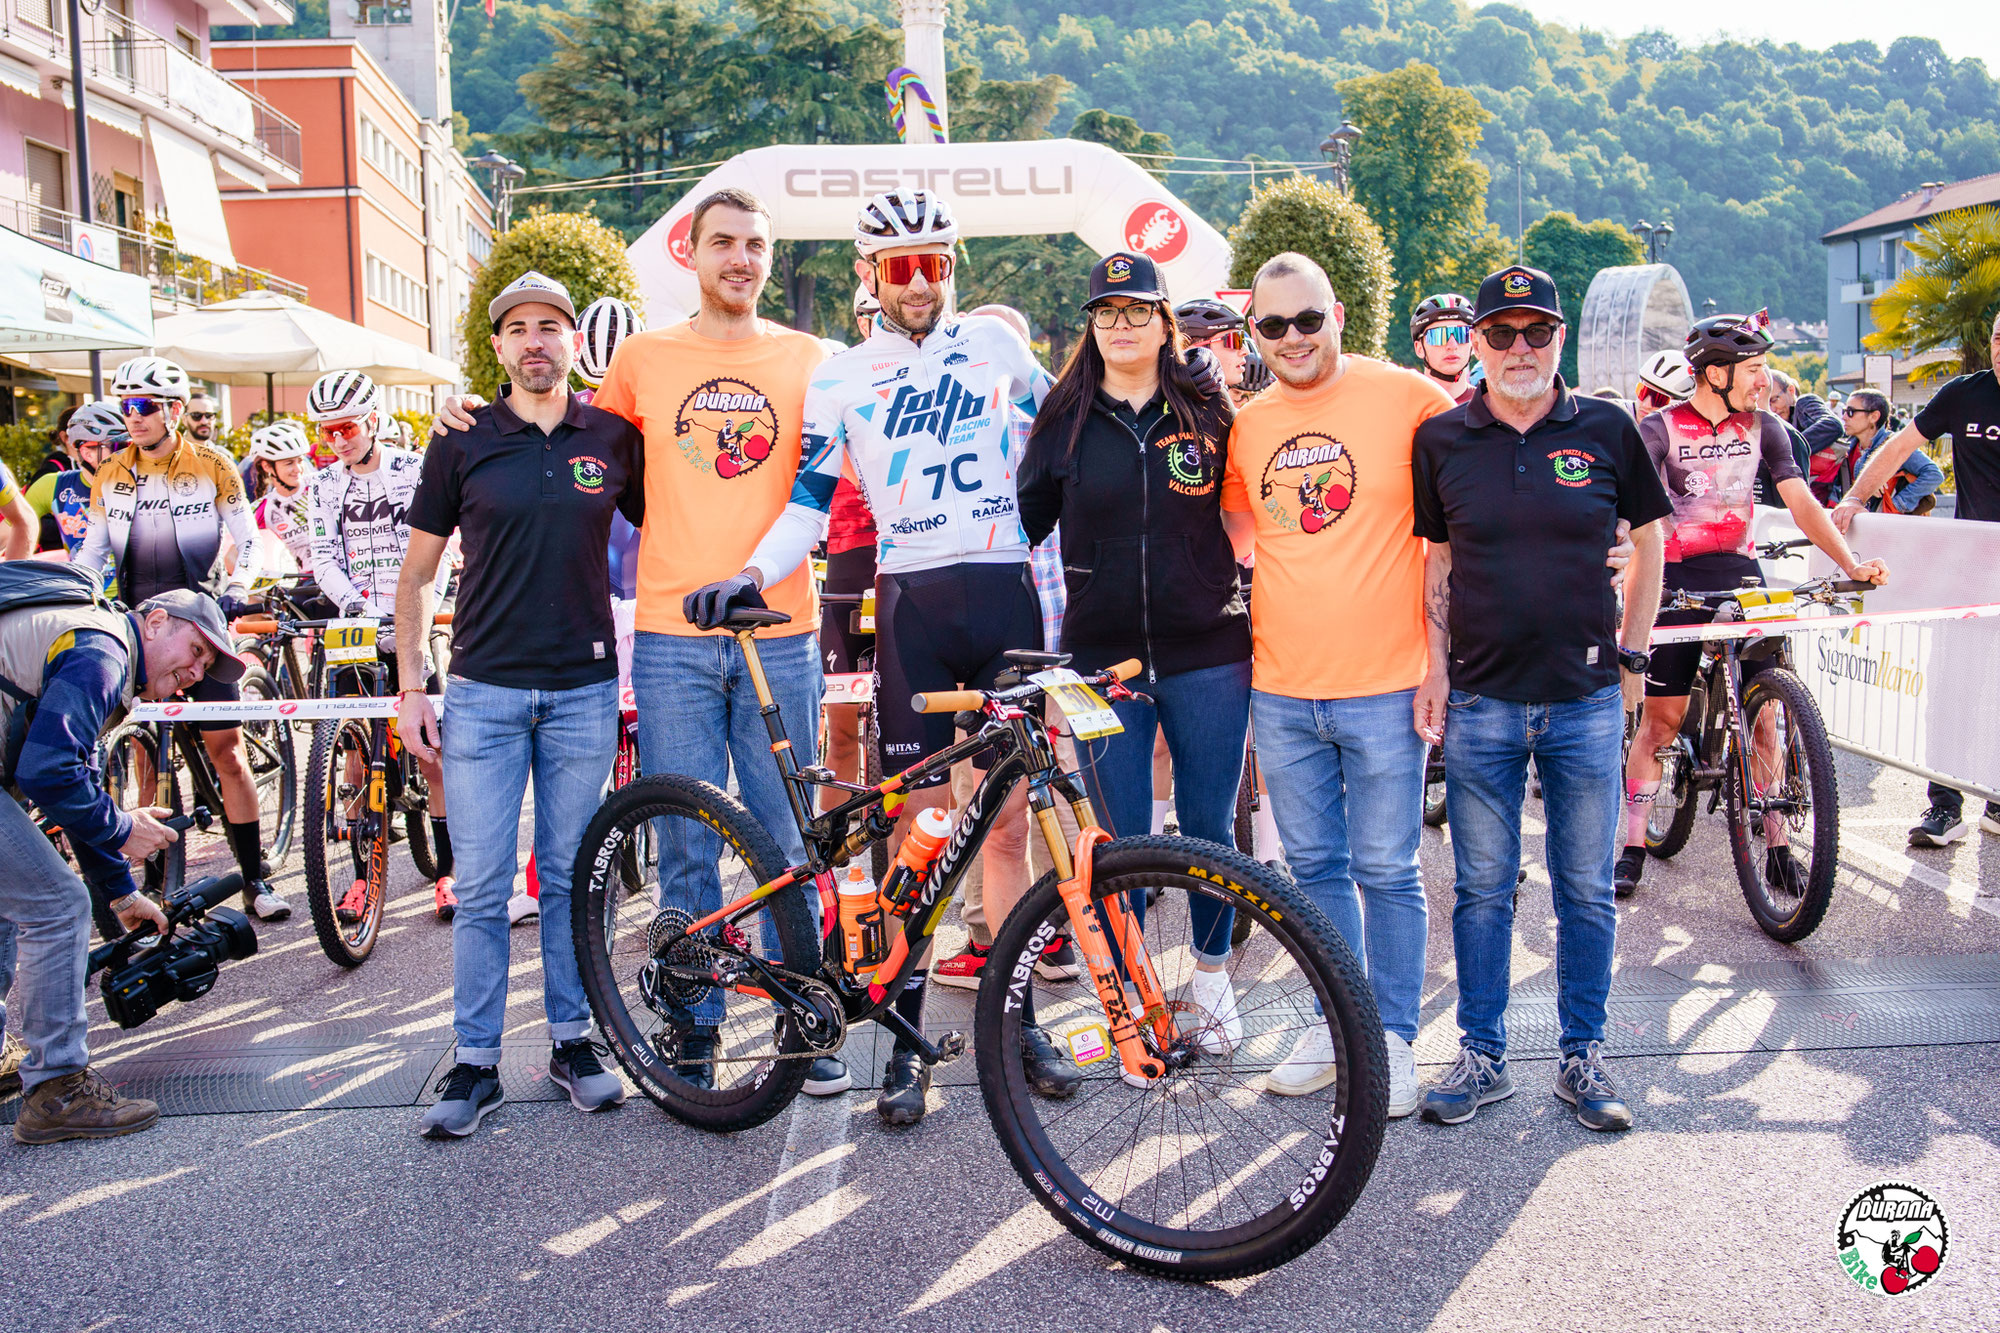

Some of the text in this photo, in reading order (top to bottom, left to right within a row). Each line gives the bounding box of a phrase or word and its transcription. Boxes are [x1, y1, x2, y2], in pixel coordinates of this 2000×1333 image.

[785, 165, 1072, 198] CASTELLI
[41, 279, 69, 297] TEST
[948, 431, 976, 446] TEAM
[952, 417, 992, 435] RACING
[677, 434, 712, 474] Bike
[1155, 433, 1178, 449] TEAM
[1546, 448, 1596, 463] TEAM PIAZZA 2000
[922, 453, 983, 501] 7C
[1168, 479, 1215, 496] VALCHIAMPO
[1555, 476, 1592, 488] VALCHIAMPO
[972, 503, 1015, 519] RAICAM
[1264, 495, 1298, 532] Bike
[339, 627, 364, 647] 10
[1058, 683, 1097, 712] 50
[895, 742, 921, 752] ITAS
[698, 808, 754, 867] MAXXIS
[588, 826, 624, 893] TABROS
[1187, 866, 1283, 922] MAXXIS
[1004, 920, 1056, 1013] TABROS
[1097, 969, 1132, 1026] FOX
[1077, 1051, 1092, 1062] DAILY
[1289, 1114, 1346, 1212] TABROS
[1096, 1227, 1183, 1264] REKON RACE
